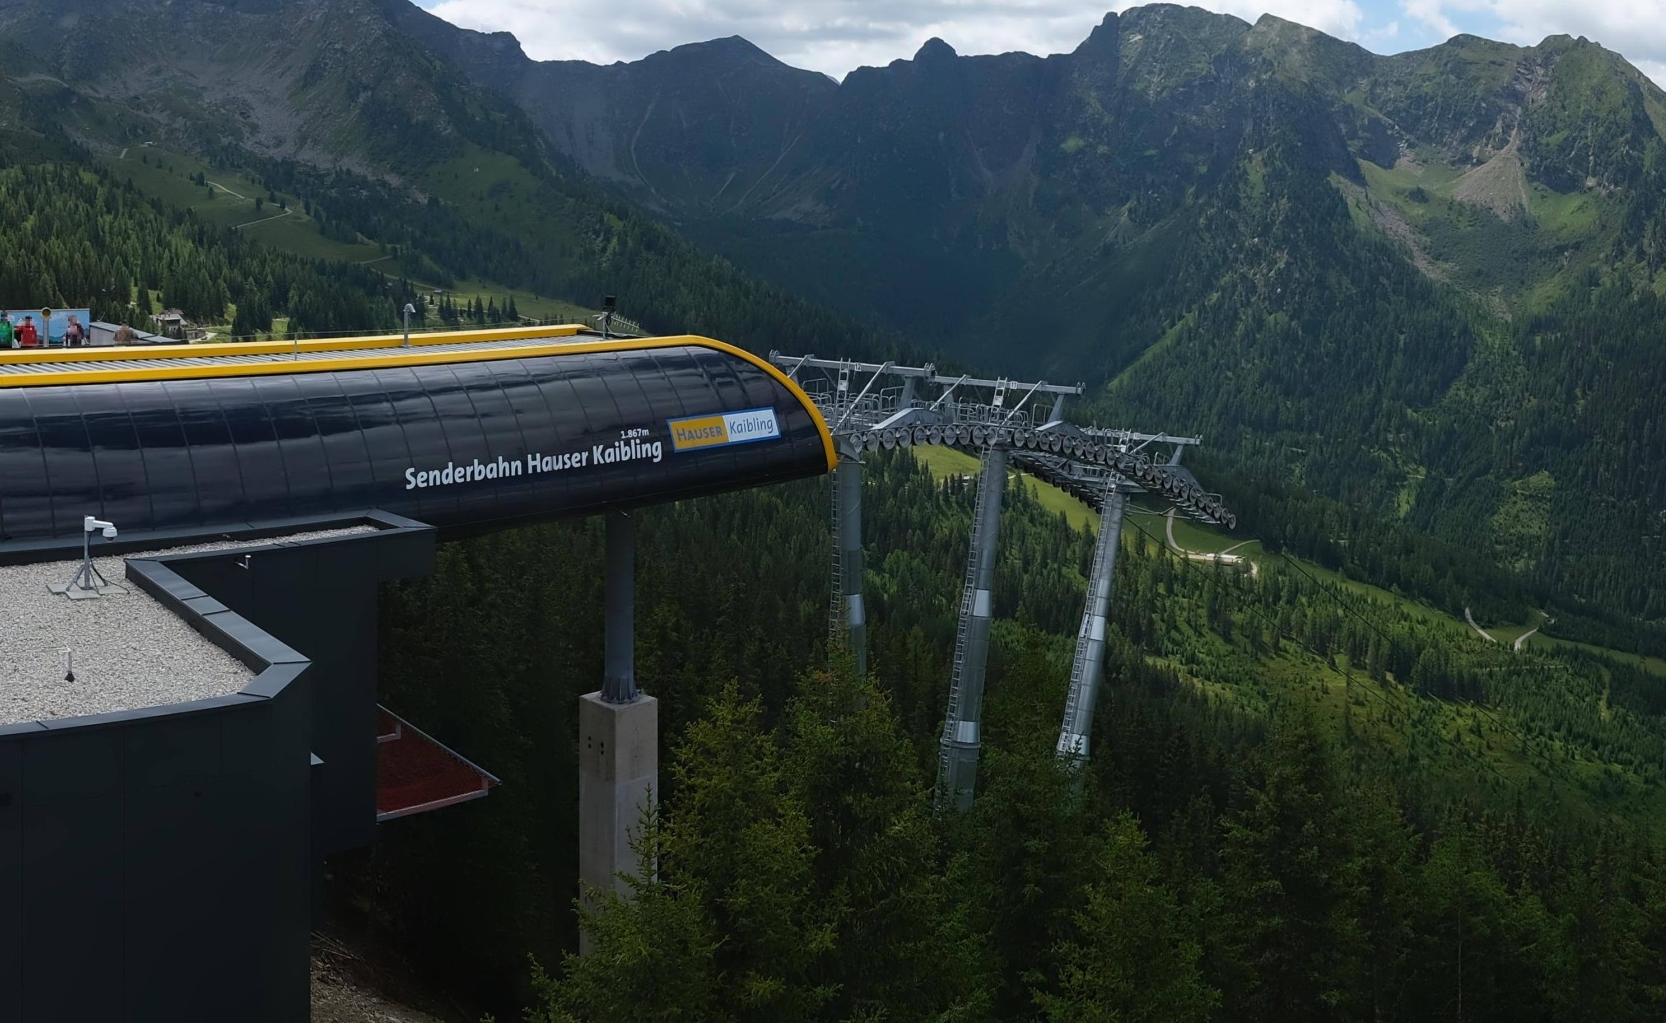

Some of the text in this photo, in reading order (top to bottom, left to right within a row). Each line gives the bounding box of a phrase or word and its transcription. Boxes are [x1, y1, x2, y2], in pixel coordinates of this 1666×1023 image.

[620, 428, 649, 439] 1.867m
[676, 418, 773, 441] HAUSER Kaibling
[405, 439, 662, 490] Senderbahn Hauser Kaibling
